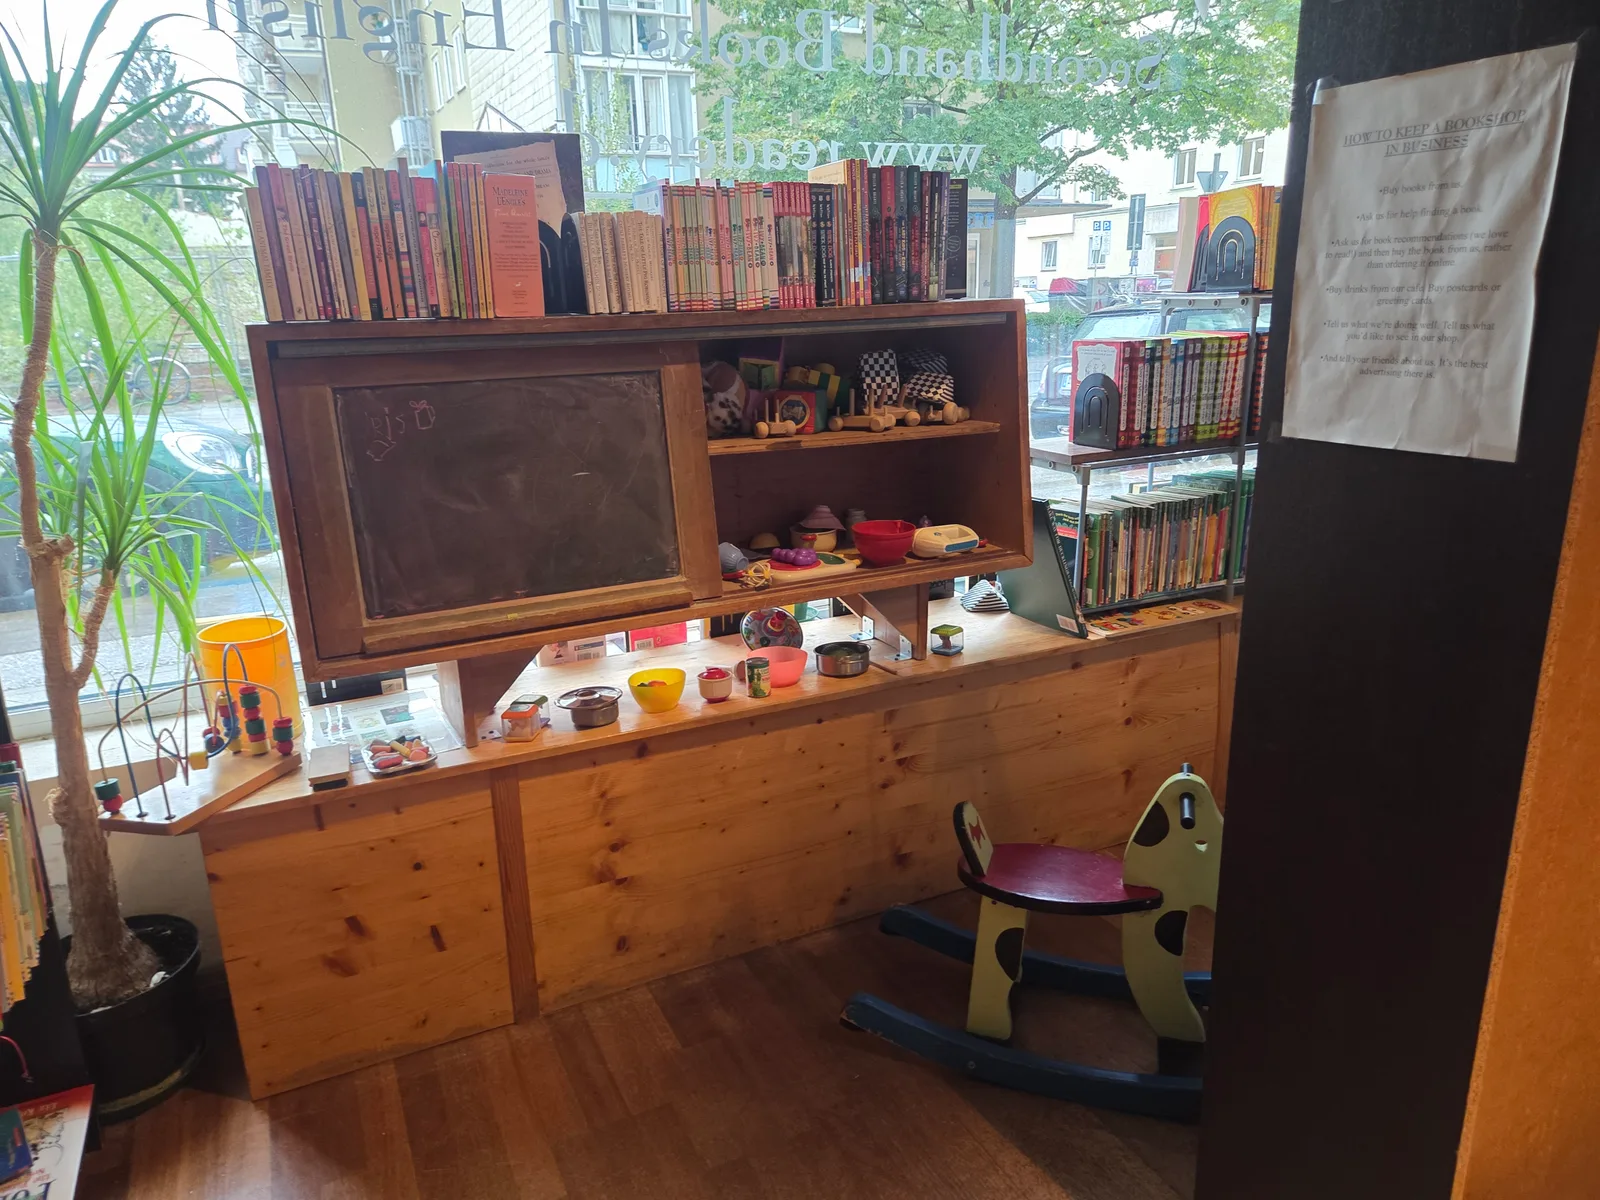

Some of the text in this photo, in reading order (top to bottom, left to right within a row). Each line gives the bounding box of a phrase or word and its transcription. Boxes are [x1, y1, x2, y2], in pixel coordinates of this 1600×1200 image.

[1344, 109, 1528, 146] HOW TO KEEP A BOOKSHOP
[1385, 134, 1469, 156] IN BUSINESS
[492, 186, 528, 196] MADELEINE
[1382, 185, 1399, 196] Buy
[1402, 183, 1426, 194] books
[1428, 182, 1450, 192] from
[1360, 212, 1374, 222] Ask
[1376, 212, 1385, 220] us
[1386, 210, 1398, 220] for
[1400, 208, 1418, 222] help
[1420, 206, 1450, 218] finding
[1335, 238, 1349, 247] Ask
[1361, 237, 1372, 246] for
[1374, 235, 1391, 245] book
[1394, 232, 1468, 244] recommendations
[1488, 230, 1508, 239] love
[1359, 249, 1372, 258] and
[1374, 248, 1390, 257] then
[1392, 247, 1407, 258] buy
[1409, 246, 1421, 255] the
[1424, 244, 1444, 255] book
[1447, 245, 1467, 254] from
[1484, 243, 1512, 252] rather
[1367, 260, 1383, 269] than
[1385, 259, 1418, 270] ordering
[1420, 259, 1427, 267] it
[1329, 286, 1343, 296] Buy
[1345, 284, 1368, 294] drinks
[1370, 284, 1389, 294] from
[1391, 285, 1404, 293] our
[1428, 283, 1444, 294] Buy
[1447, 283, 1488, 294] postcards
[1491, 283, 1501, 292] or
[1377, 297, 1409, 307] greeting
[1326, 320, 1339, 329] Tell
[1341, 321, 1349, 329] us
[1351, 320, 1368, 329] what
[1370, 320, 1392, 329] we're
[1394, 320, 1417, 331] doing
[1420, 320, 1439, 330] well.
[1443, 321, 1458, 330] Tell
[1473, 321, 1495, 331] what
[1345, 332, 1367, 342] you'd
[1369, 332, 1384, 341] like
[1386, 332, 1394, 341] to
[1411, 333, 1419, 342] in
[1421, 335, 1436, 343] our
[1438, 333, 1459, 345] shop.
[1323, 353, 1489, 369] And tell your friends about us. It's the best
[1359, 367, 1435, 379] advertising there is.
